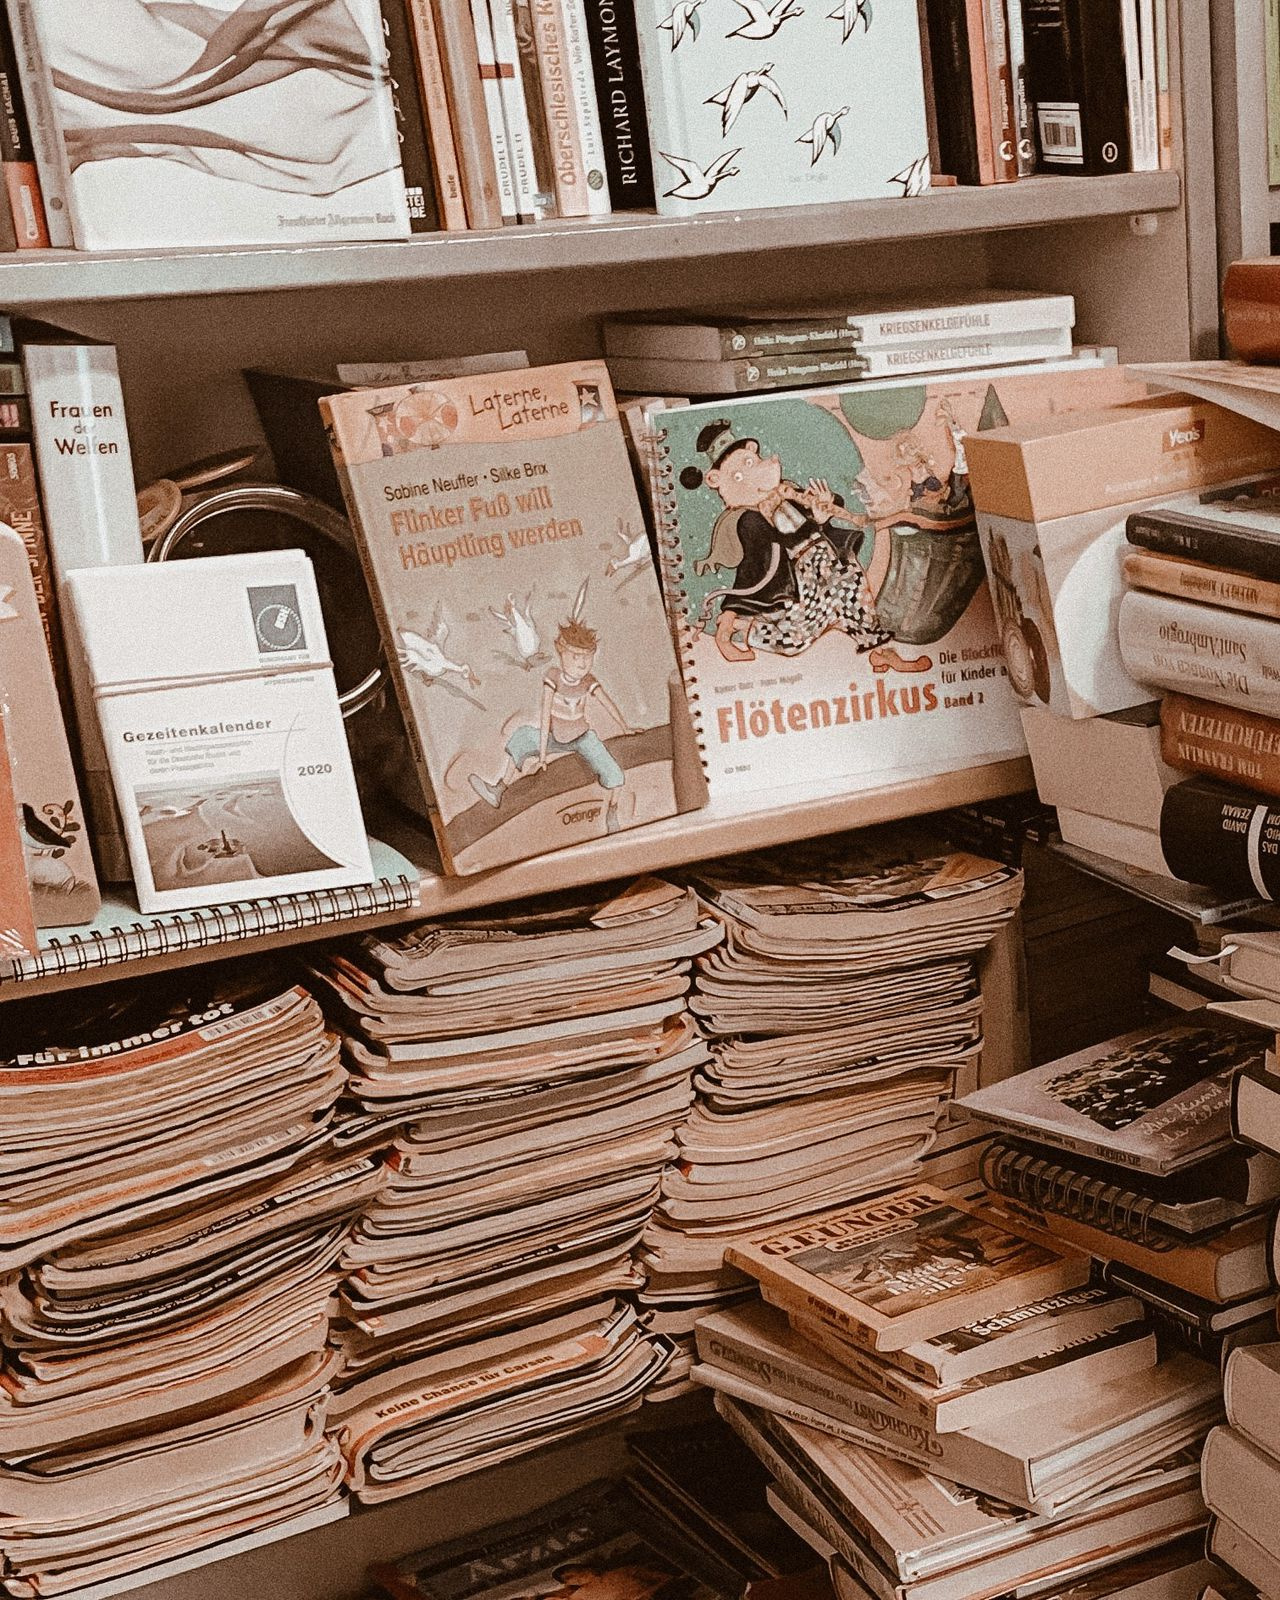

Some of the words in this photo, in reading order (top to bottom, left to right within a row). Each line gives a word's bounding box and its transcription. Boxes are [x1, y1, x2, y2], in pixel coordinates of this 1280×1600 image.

[543, 22, 576, 186] Oberschlesisches
[611, 89, 638, 185] RICHARD
[498, 146, 512, 197] DRUDEL
[517, 145, 530, 195] DRUDEL
[879, 313, 991, 337] KRIEGSENKELGEFÜHLE
[886, 342, 993, 367] KRIEGSENKELGEFÜHLE
[50, 400, 113, 419] Frauen
[469, 385, 549, 418] Laterne,
[500, 399, 570, 432] Laterne
[384, 481, 430, 502] Sabine
[432, 471, 480, 494] Neuffer
[490, 466, 522, 485] Silke
[524, 460, 549, 480] Brix
[389, 504, 464, 537] Flinker
[469, 495, 511, 521] Fuß
[515, 486, 553, 514] will
[400, 531, 506, 571] Häuptling
[507, 515, 584, 548] werden
[939, 650, 957, 666] Die
[941, 668, 957, 684] für
[961, 665, 996, 682] Kinder
[716, 679, 938, 744] Flötenzirkus
[944, 693, 974, 709] Band
[122, 718, 273, 744] Gezeitenkalender
[298, 763, 333, 777] 2020
[1179, 742, 1230, 772] FRANKLIN
[1231, 757, 1262, 780] TOM
[1221, 803, 1252, 820] ZEMAN
[1221, 818, 1248, 835] DAVID
[1261, 840, 1279, 855] DAS
[78, 1020, 184, 1060] immer
[188, 1001, 235, 1026] tot
[971, 1287, 1108, 1337] Schmutzigen
[375, 1395, 420, 1420] Keine
[420, 1377, 478, 1402] Chance
[478, 1369, 501, 1386] für
[503, 1354, 555, 1376] Carson
